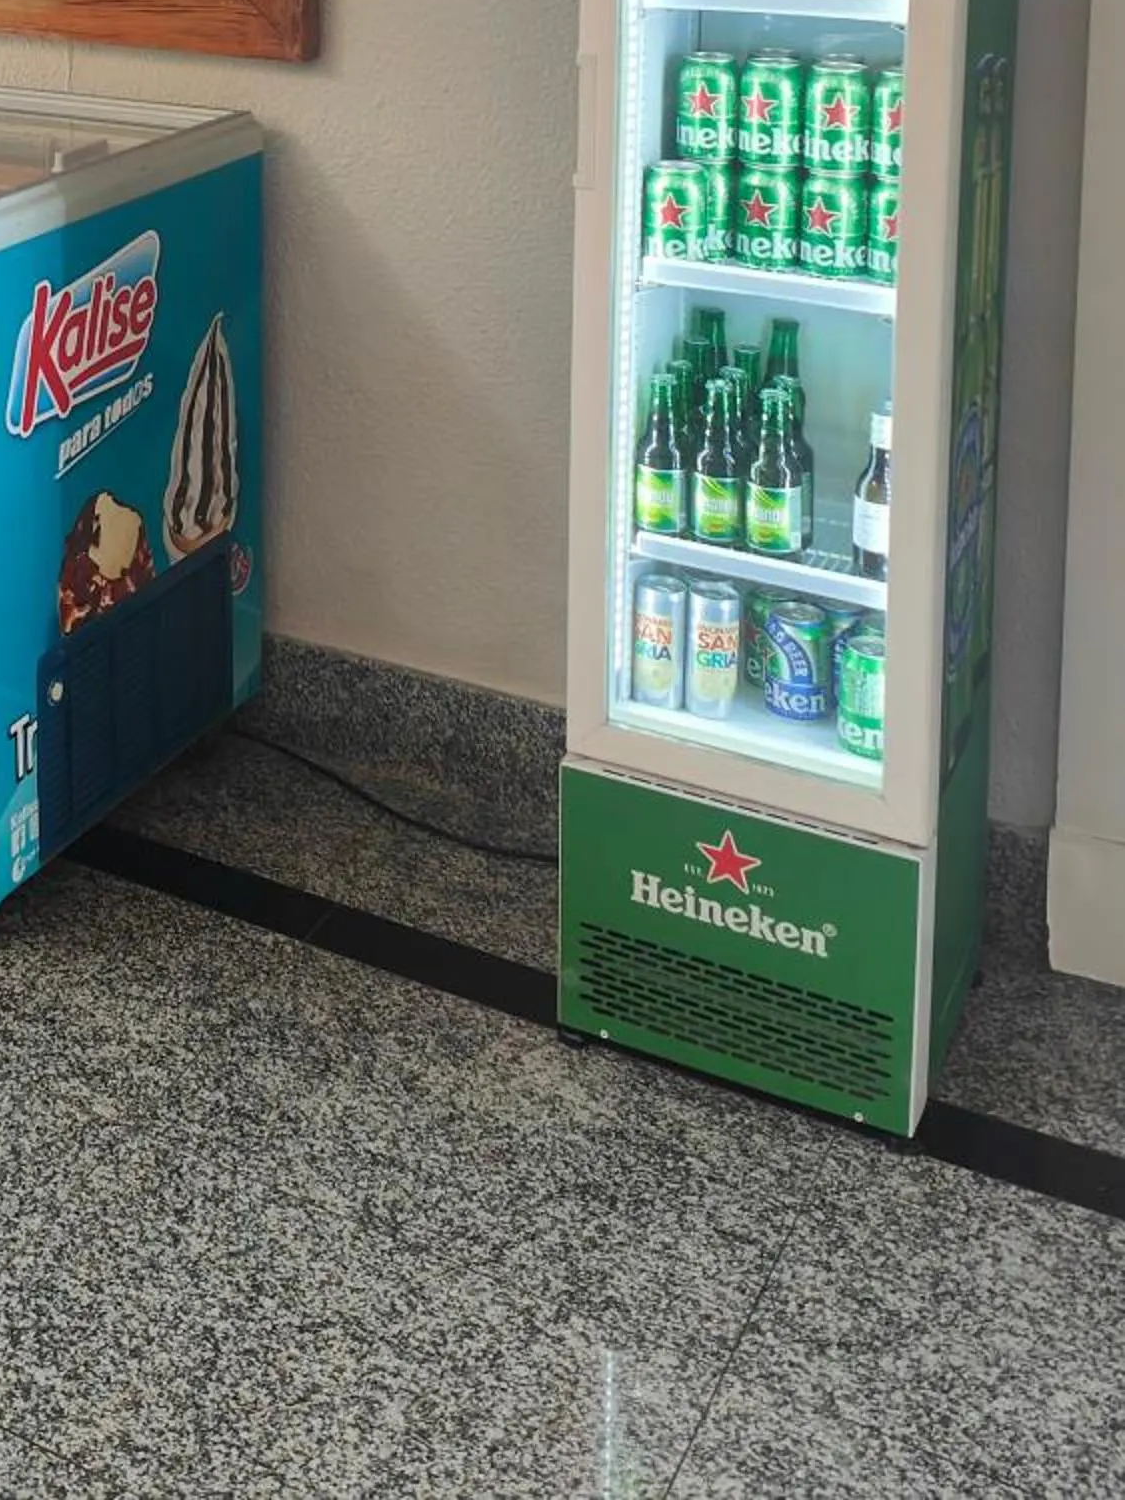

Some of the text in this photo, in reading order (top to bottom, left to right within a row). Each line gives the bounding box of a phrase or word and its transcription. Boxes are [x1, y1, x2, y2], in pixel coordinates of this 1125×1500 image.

[21, 274, 157, 438] Kalise
[59, 371, 154, 470] para todos
[631, 870, 828, 957] Heineken
